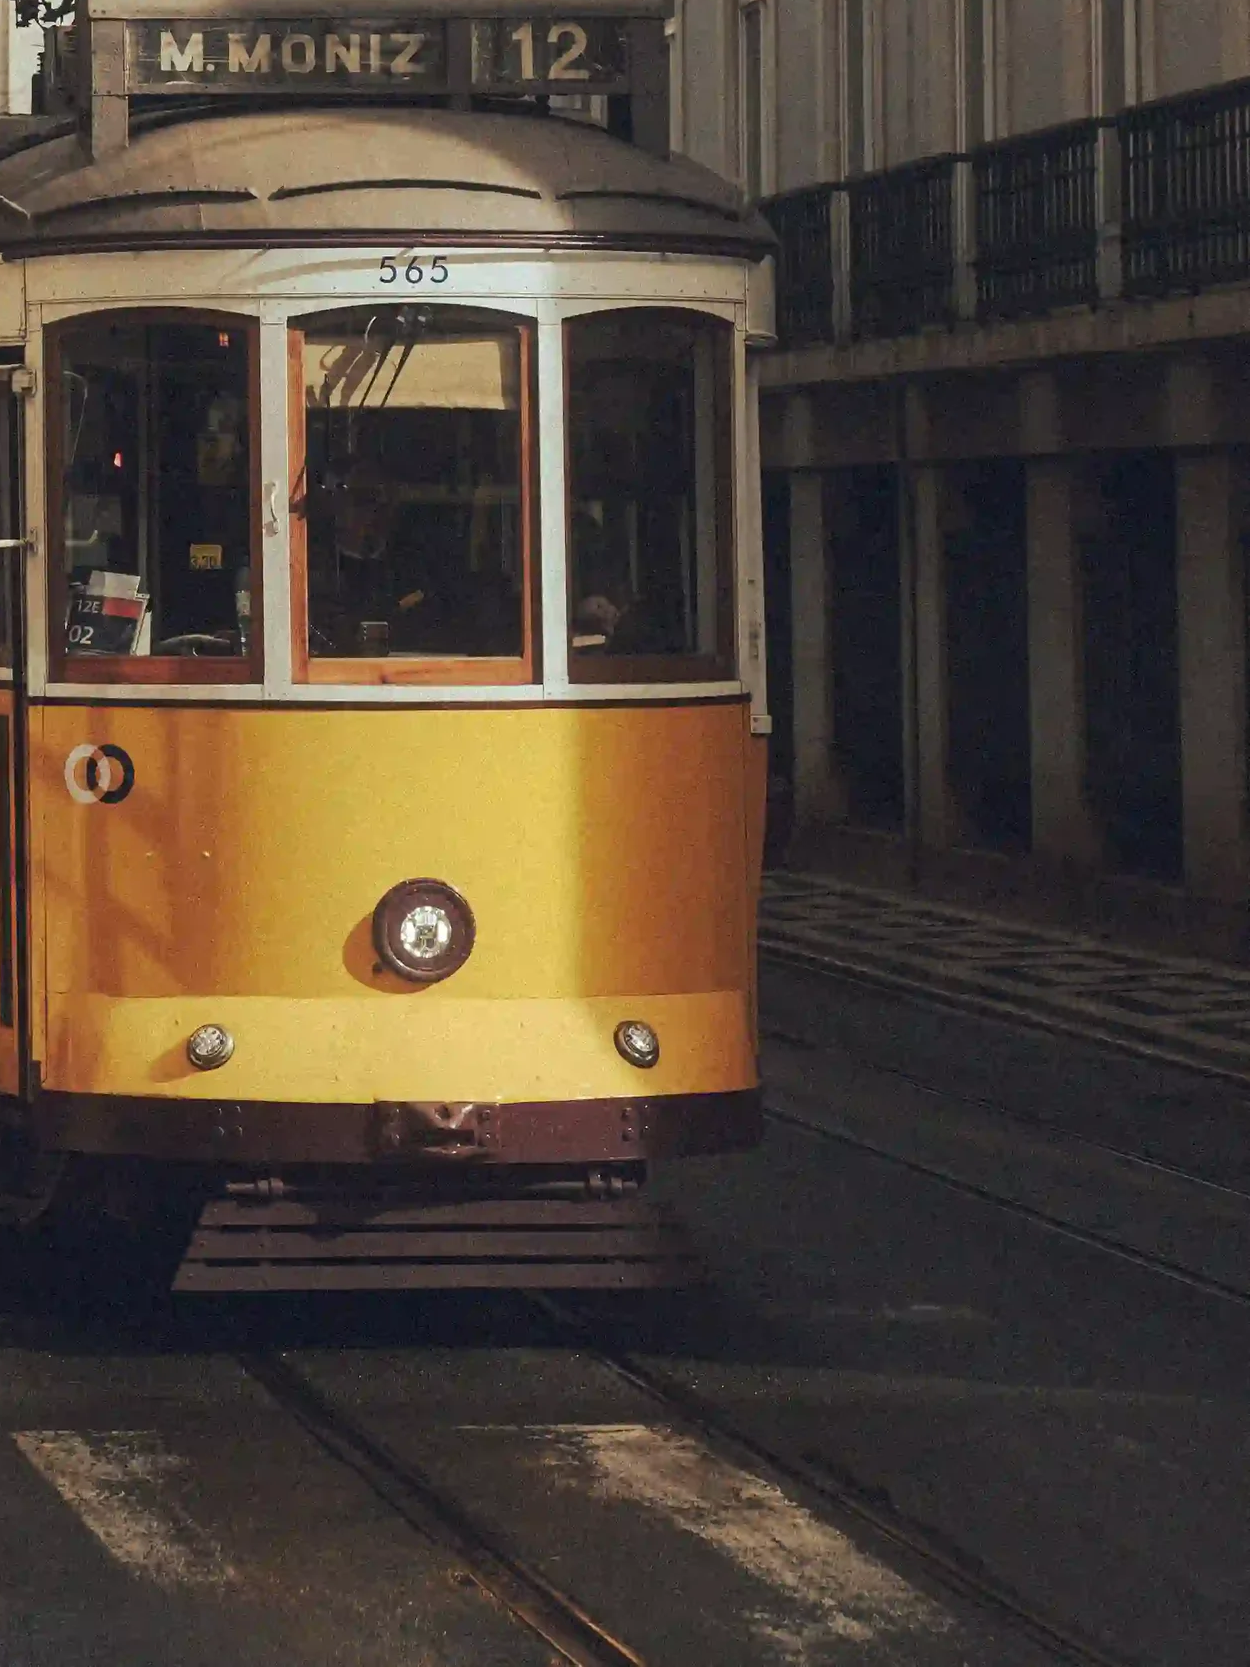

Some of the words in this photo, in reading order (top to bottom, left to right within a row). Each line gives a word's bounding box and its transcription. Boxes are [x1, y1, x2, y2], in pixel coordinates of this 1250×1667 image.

[511, 23, 590, 80] 12
[378, 256, 449, 284] 565
[68, 624, 95, 645] 02
